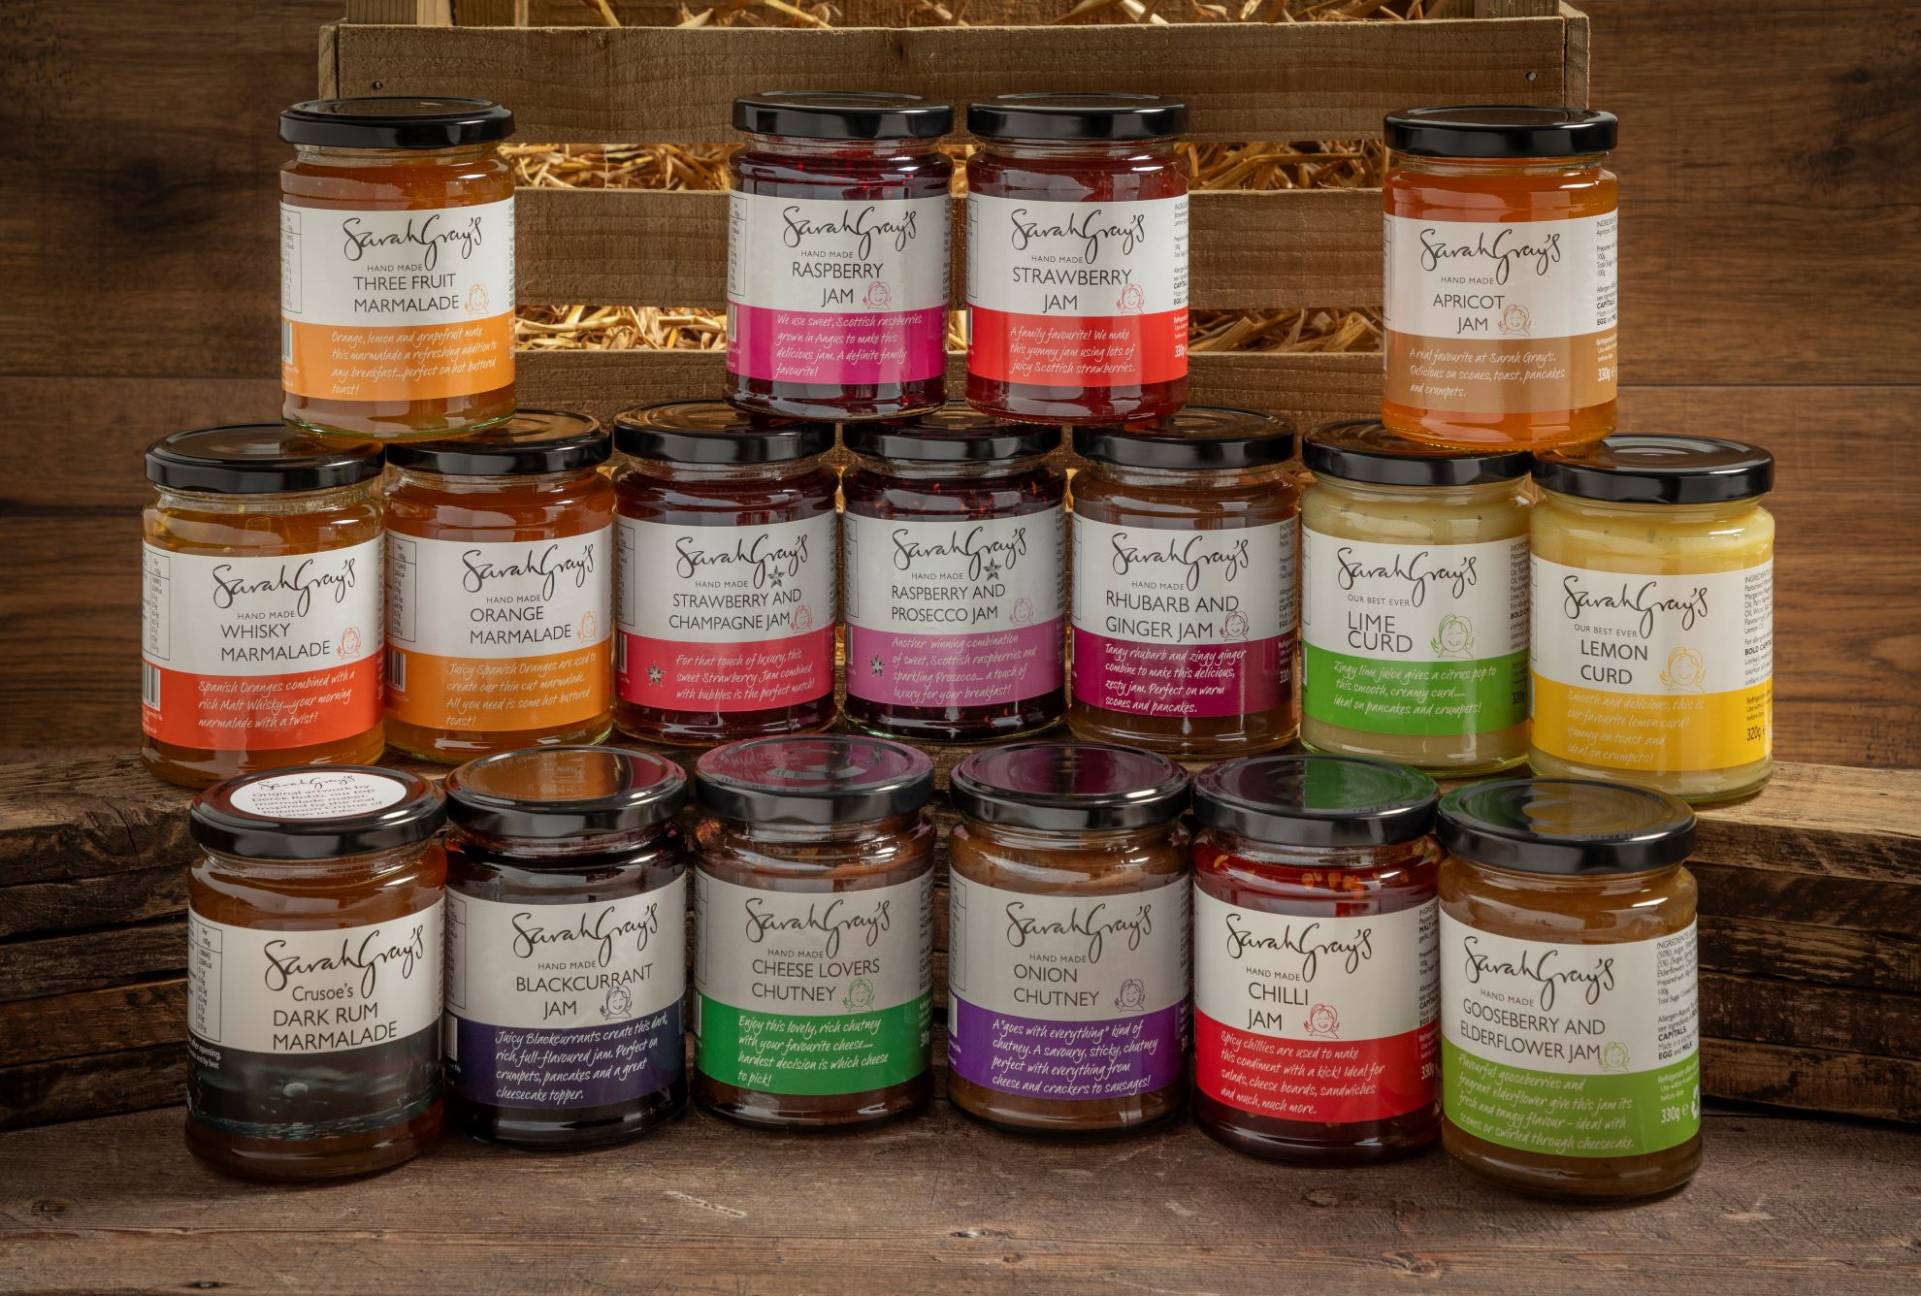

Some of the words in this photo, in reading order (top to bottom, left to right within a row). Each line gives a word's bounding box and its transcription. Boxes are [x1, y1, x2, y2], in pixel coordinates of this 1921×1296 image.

[793, 262, 884, 279] RASPBERRY
[1013, 267, 1132, 285] STRAWBERRY
[353, 276, 406, 291] THREE
[412, 273, 456, 289] FRUIT
[1469, 277, 1494, 285] MADE
[354, 295, 459, 312] MARMALADE
[821, 288, 854, 307] JAM
[1043, 295, 1077, 313] JAM
[1433, 294, 1504, 309] APRICOT
[1457, 317, 1488, 334] JAM
[724, 580, 749, 588] MADE
[892, 585, 968, 600] RASPBERRY
[973, 584, 1005, 599] AND
[517, 595, 541, 603] MADE
[673, 593, 768, 608] STRAWBERRY
[773, 589, 801, 605] AND
[1106, 590, 1189, 613] RHUBARB
[1196, 595, 1238, 613] AND
[1347, 594, 1363, 603] OUR
[1367, 597, 1385, 605] BEST
[1389, 597, 1410, 606] EVER
[269, 611, 295, 619] MADE
[471, 606, 544, 622] ORANGE
[669, 614, 762, 630] CHAMPAGNE
[766, 612, 790, 631] JAM
[892, 607, 968, 621] PROSECCO
[971, 606, 998, 624] JAM
[1348, 611, 1395, 633] LIME
[221, 623, 290, 639] WHISKY
[471, 624, 571, 644] MARMALADE
[1106, 616, 1172, 638] GINGER
[1178, 623, 1213, 642] JAM
[1574, 624, 1590, 633] OUR
[1594, 627, 1612, 635] BEST
[1616, 629, 1637, 637] EVER
[221, 641, 330, 661] MARMALADE
[1348, 631, 1413, 653] CURD
[1581, 639, 1647, 661] LEMON
[1580, 664, 1632, 684] CURD
[768, 949, 794, 957] HAND
[1030, 954, 1056, 962] HAND
[570, 961, 596, 969] MADE
[752, 959, 813, 978] CHEESE
[820, 959, 879, 978] LOVERS
[1014, 964, 1077, 983] ONION
[1246, 967, 1271, 977] HAND
[1275, 972, 1300, 981] MADE
[517, 964, 653, 992] BLACKCURRANT
[292, 983, 353, 1001] Crusoe's
[752, 983, 836, 1001] CHUTNEY
[1014, 987, 1099, 1007] CHUTNEY
[1248, 982, 1308, 1006] CHILLI
[1480, 989, 1504, 1001] HAND
[1508, 995, 1534, 1007] MADE
[273, 1009, 329, 1027] DARK
[336, 1002, 378, 1023] RUM
[543, 1001, 577, 1020] JAM
[1247, 1009, 1282, 1030] JAM
[1464, 998, 1559, 1033] GOOSEBERRY
[1565, 1019, 1605, 1035] AND
[273, 1021, 397, 1050] MARMALADE
[1461, 1021, 1565, 1060] ELDERFLOWER
[1567, 1043, 1600, 1063] JAM
